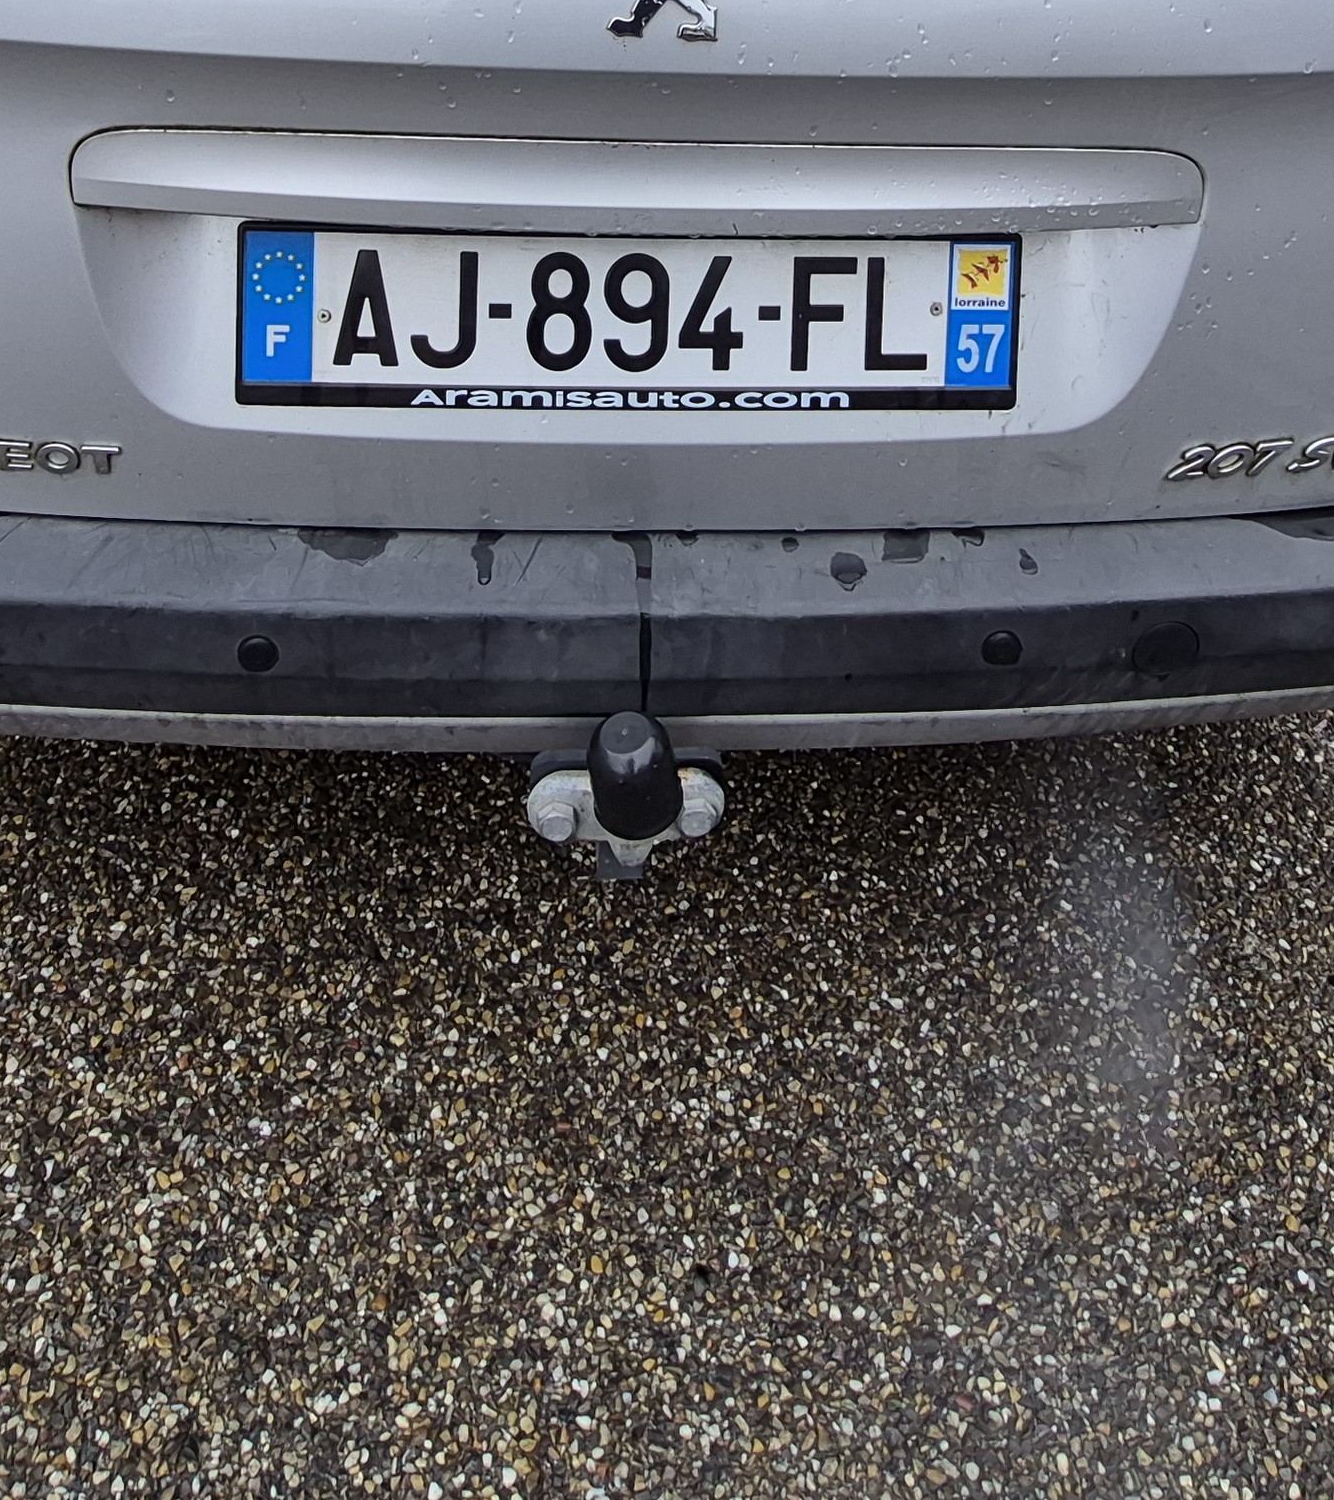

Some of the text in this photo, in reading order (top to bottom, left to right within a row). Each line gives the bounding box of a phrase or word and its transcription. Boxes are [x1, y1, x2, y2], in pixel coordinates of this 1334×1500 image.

[332, 248, 929, 373] AJ-894-FL
[954, 298, 1006, 308] lorraine
[265, 325, 289, 357] F
[956, 324, 1005, 373] 57
[410, 388, 851, 408] Aramisauto.com
[1164, 437, 1294, 482] 207
